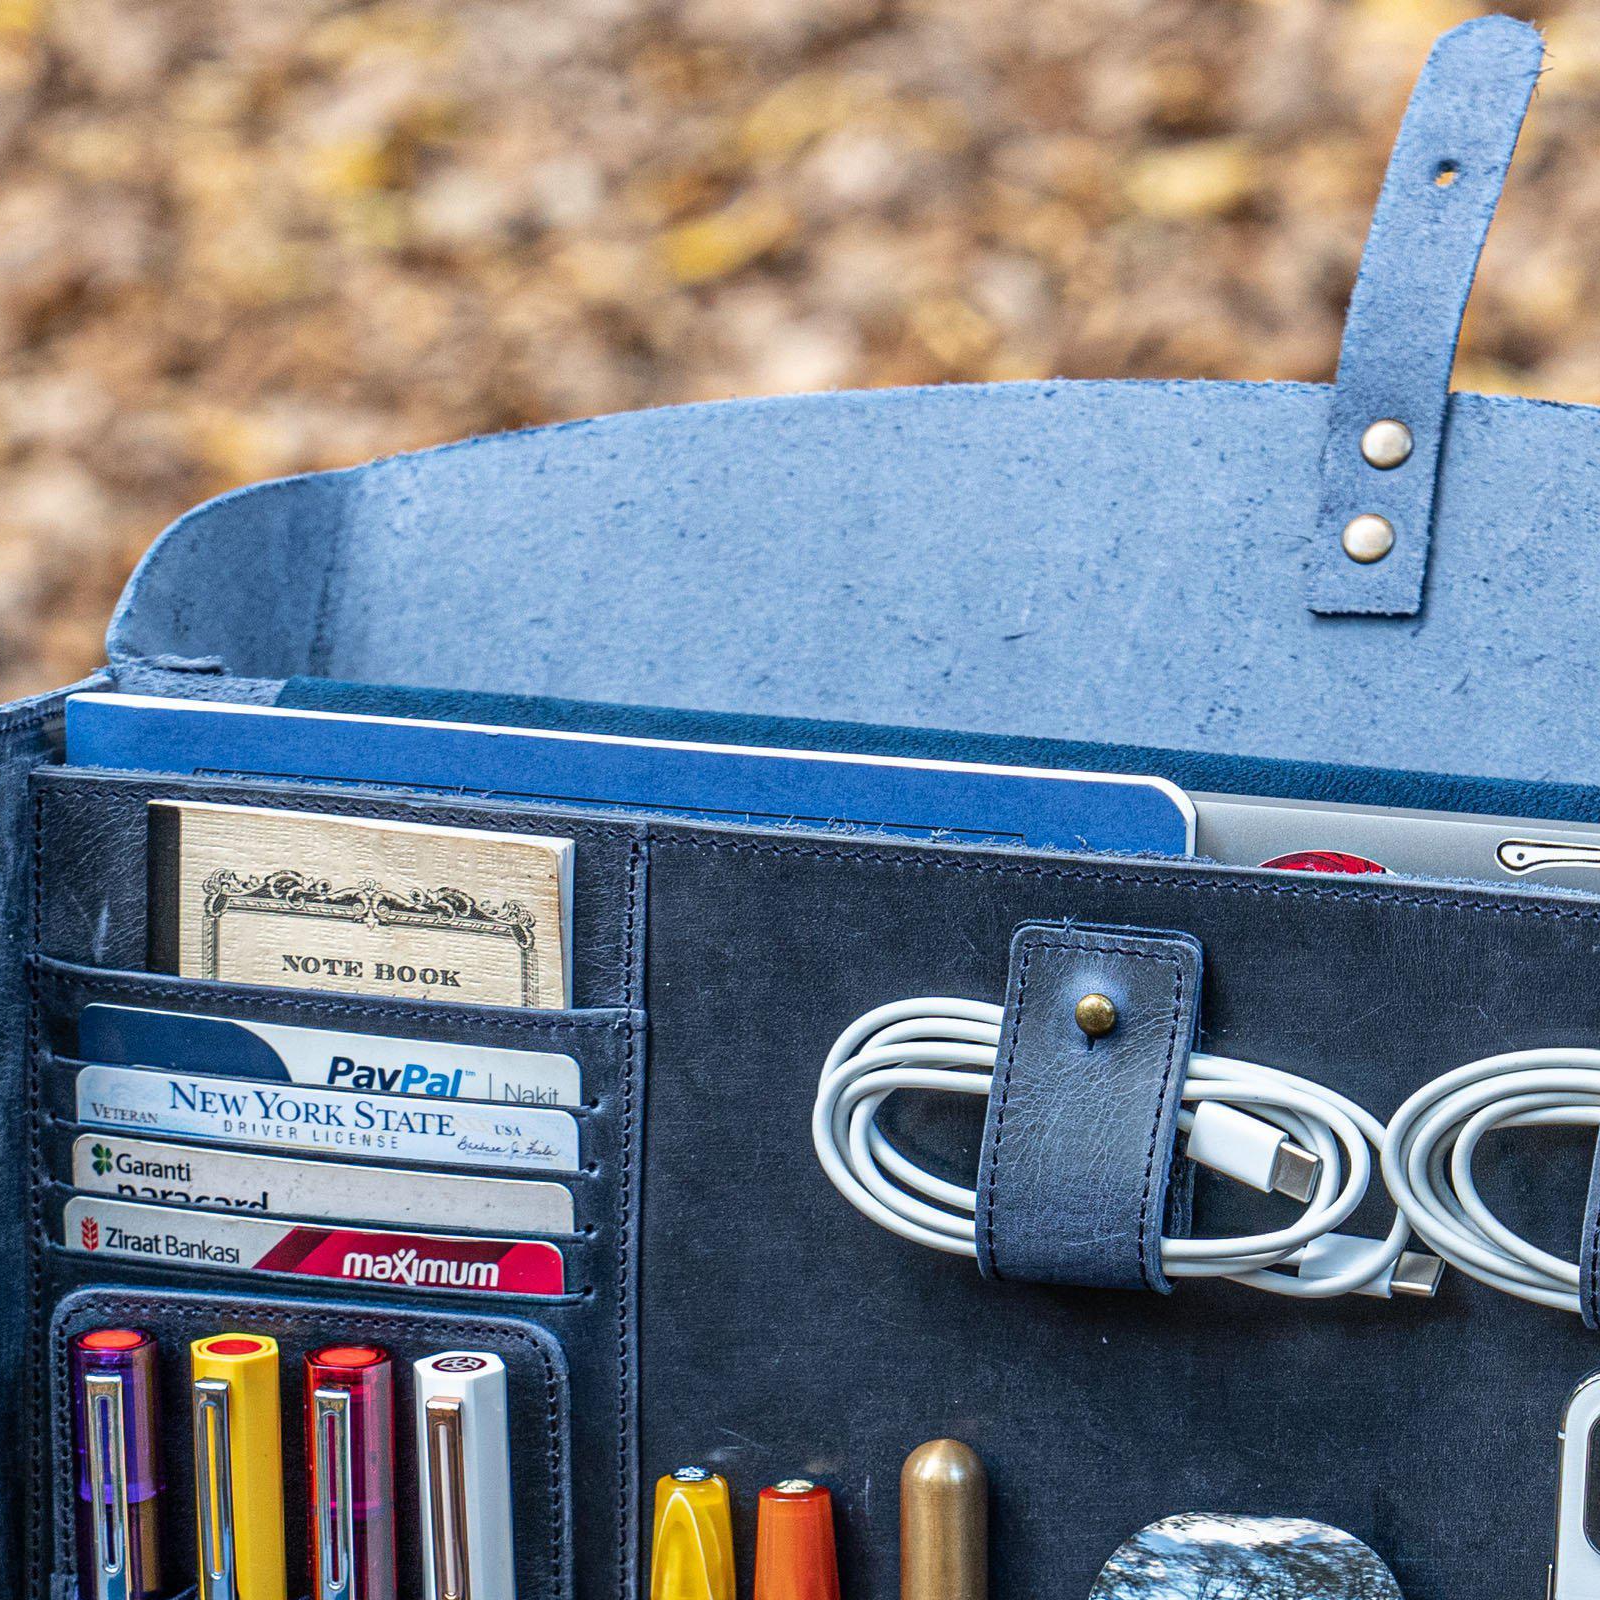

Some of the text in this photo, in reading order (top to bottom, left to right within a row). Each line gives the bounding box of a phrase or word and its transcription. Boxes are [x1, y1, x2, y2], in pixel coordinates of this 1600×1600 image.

[281, 954, 462, 988] NOTE BOOK
[224, 1120, 399, 1150] DRIVER LICENSE
[494, 1124, 522, 1137] USA
[115, 1152, 191, 1182] Garanti
[105, 1227, 162, 1255] Ziraat
